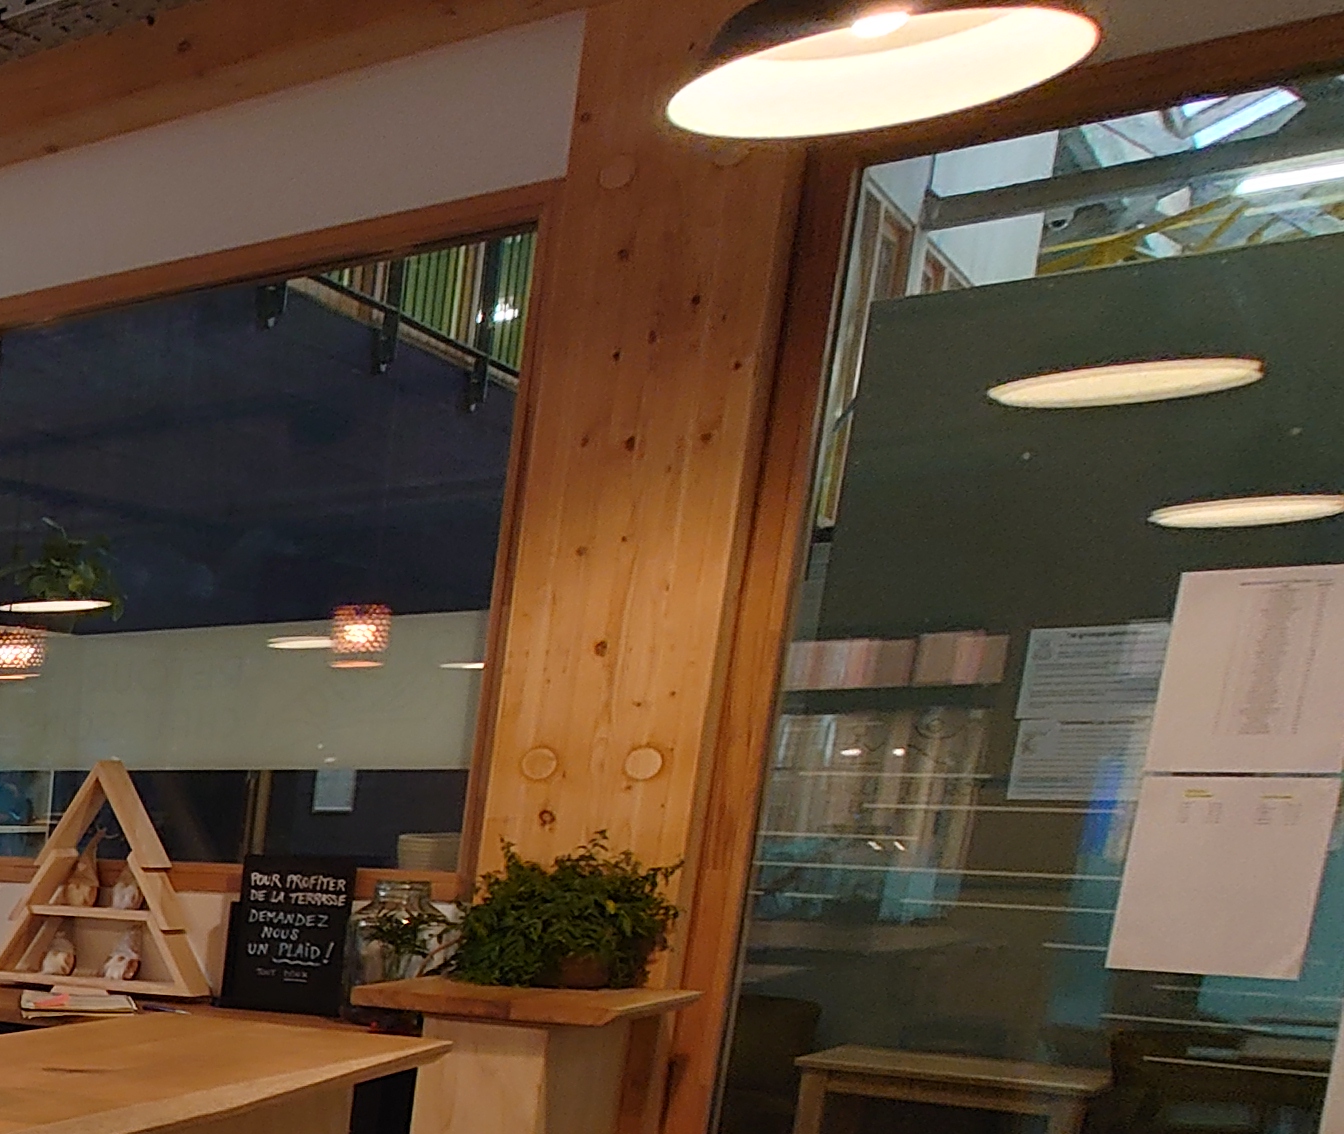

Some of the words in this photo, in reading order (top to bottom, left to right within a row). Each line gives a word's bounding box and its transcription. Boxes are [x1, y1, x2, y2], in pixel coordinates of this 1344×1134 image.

[250, 871, 282, 888] POUR
[285, 873, 348, 892] PROFITER
[249, 889, 266, 902] DE
[269, 890, 285, 904] LA
[288, 892, 348, 908] TERRASSE
[247, 908, 329, 929] DEMANDEZ
[260, 926, 300, 941] NOUS
[247, 942, 269, 957] UN
